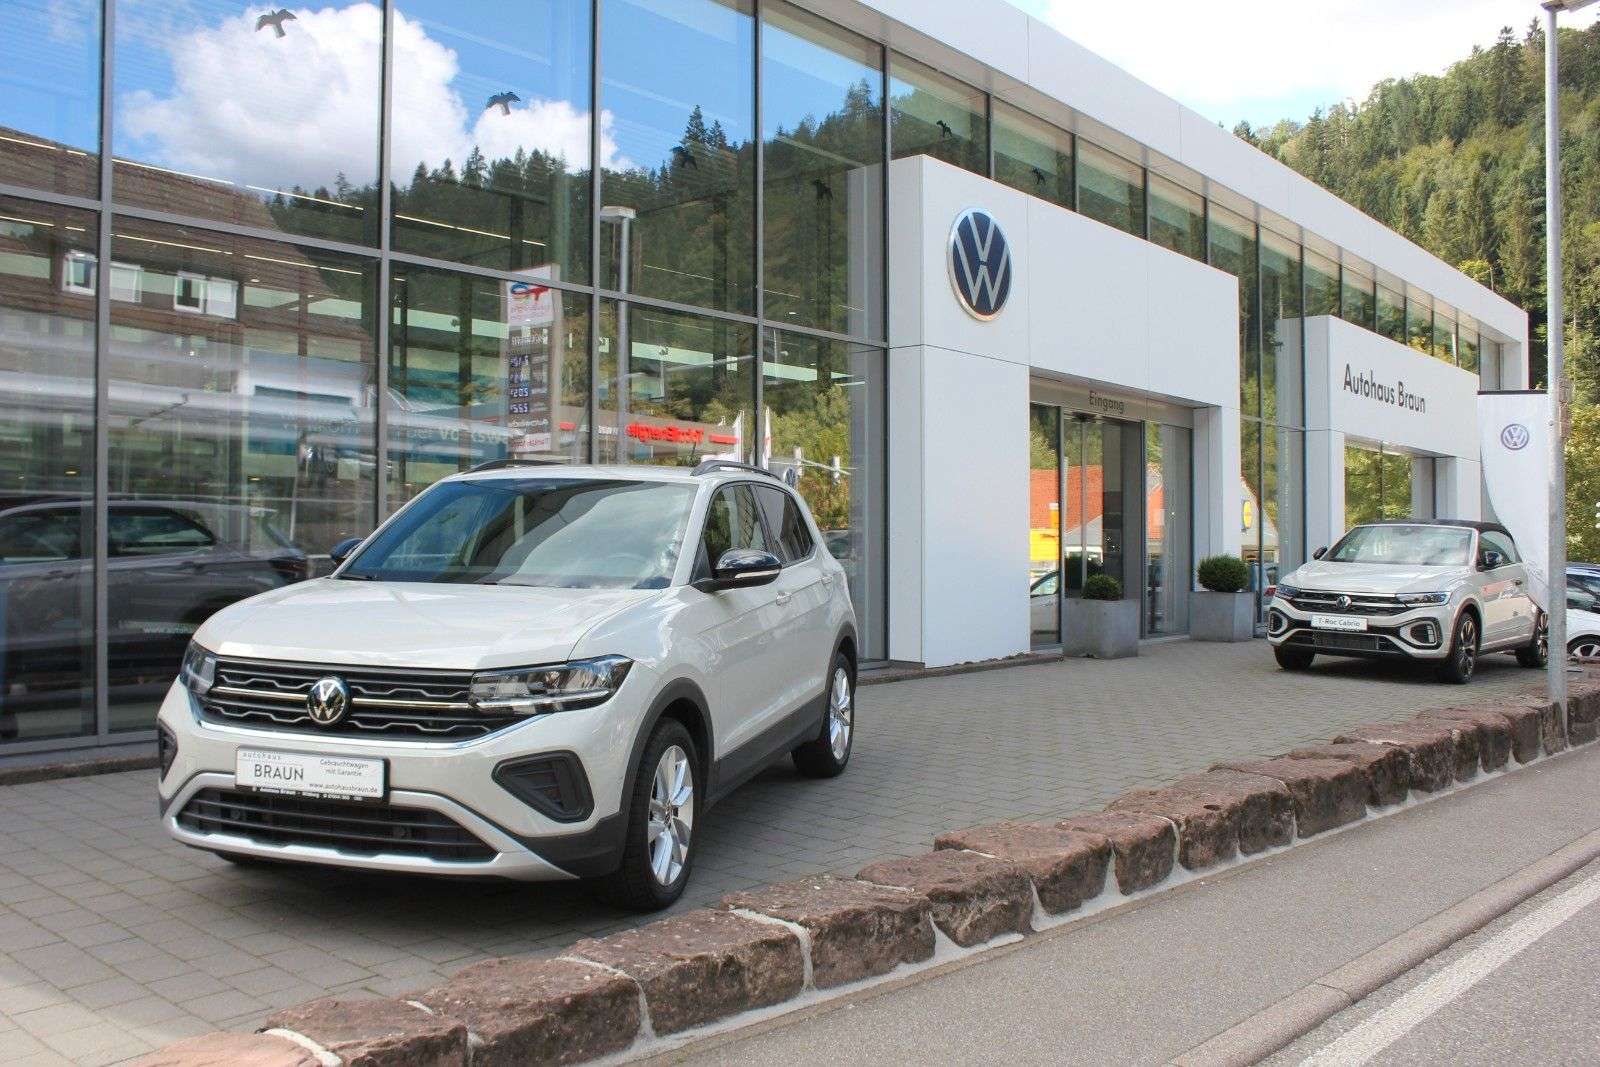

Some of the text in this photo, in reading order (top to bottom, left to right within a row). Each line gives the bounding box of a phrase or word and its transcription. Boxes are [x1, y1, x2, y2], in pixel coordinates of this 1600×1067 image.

[1343, 363, 1426, 413] Autohaus Braun
[1089, 390, 1125, 415] Eingang
[1318, 617, 1337, 625] T-Roc
[243, 752, 281, 760] autohaus
[254, 764, 304, 781] BRAUN
